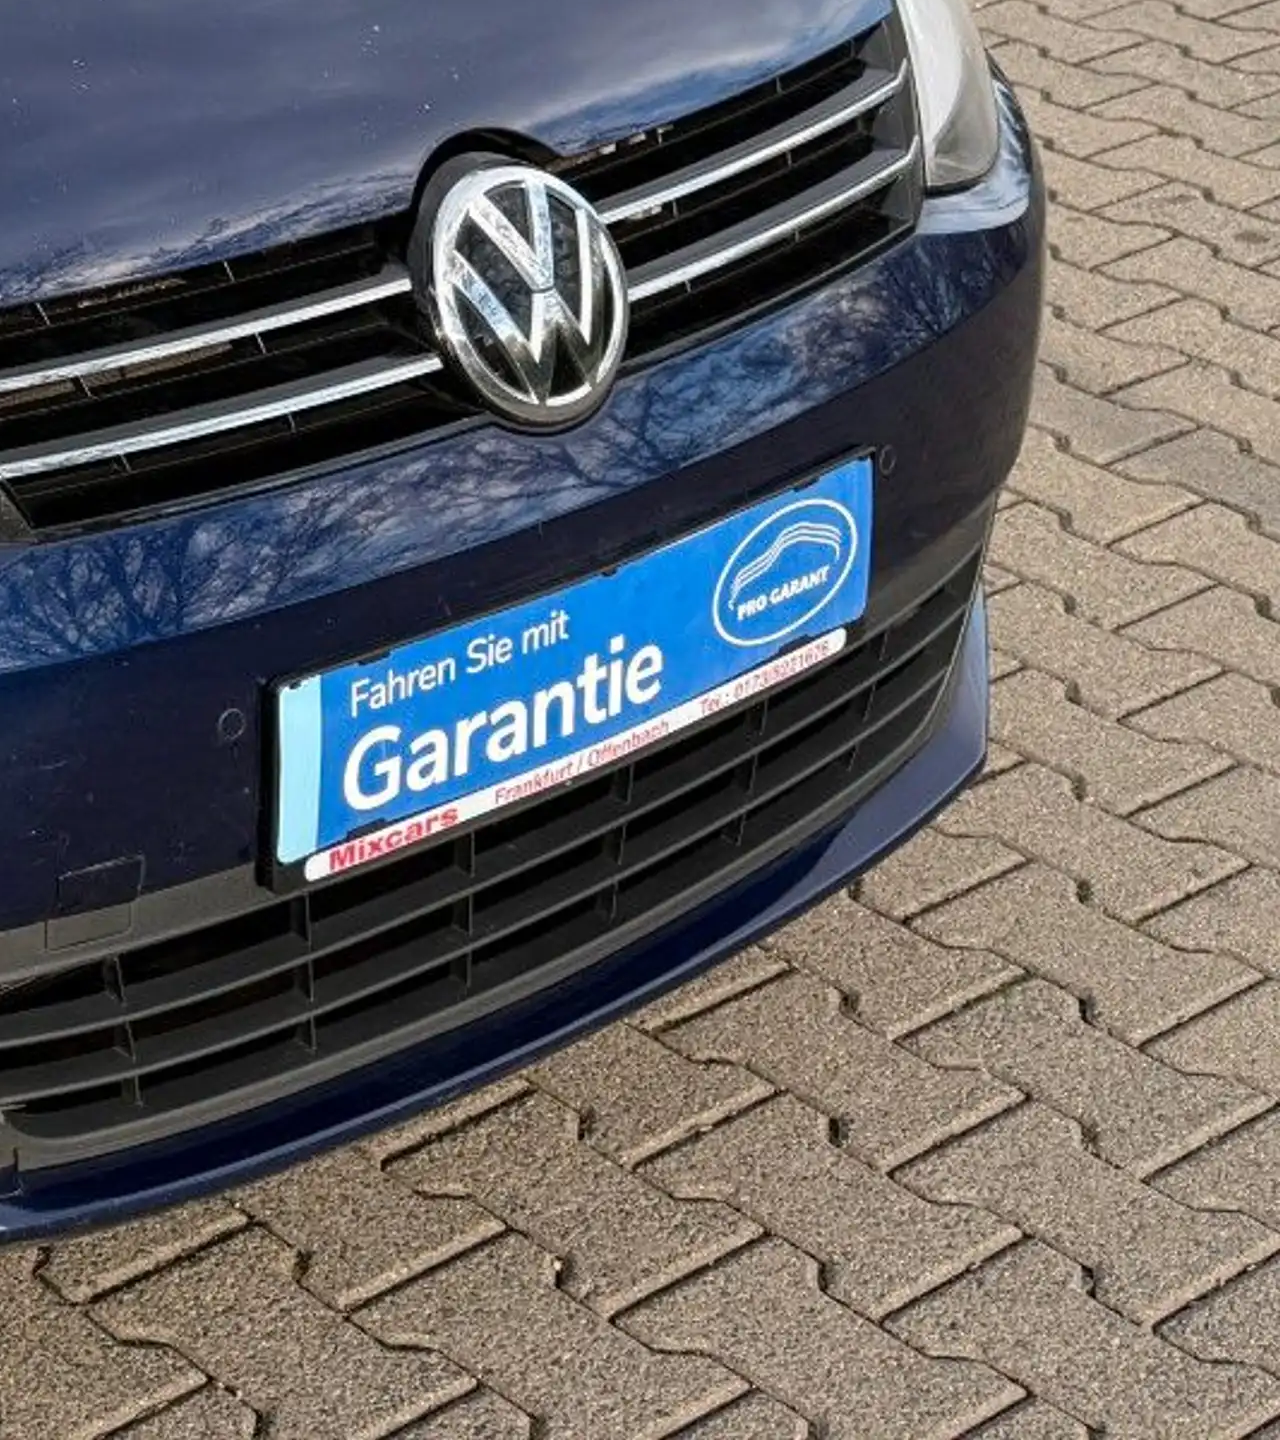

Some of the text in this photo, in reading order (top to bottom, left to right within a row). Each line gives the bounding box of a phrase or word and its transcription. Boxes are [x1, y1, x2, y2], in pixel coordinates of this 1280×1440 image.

[737, 564, 830, 621] PRO GARANT
[343, 634, 665, 811] Garantie
[350, 609, 571, 719] Fahren Sie mit
[328, 806, 460, 872] Mixcars
[494, 759, 574, 805] Frankfurt
[588, 720, 670, 768] Offenbach
